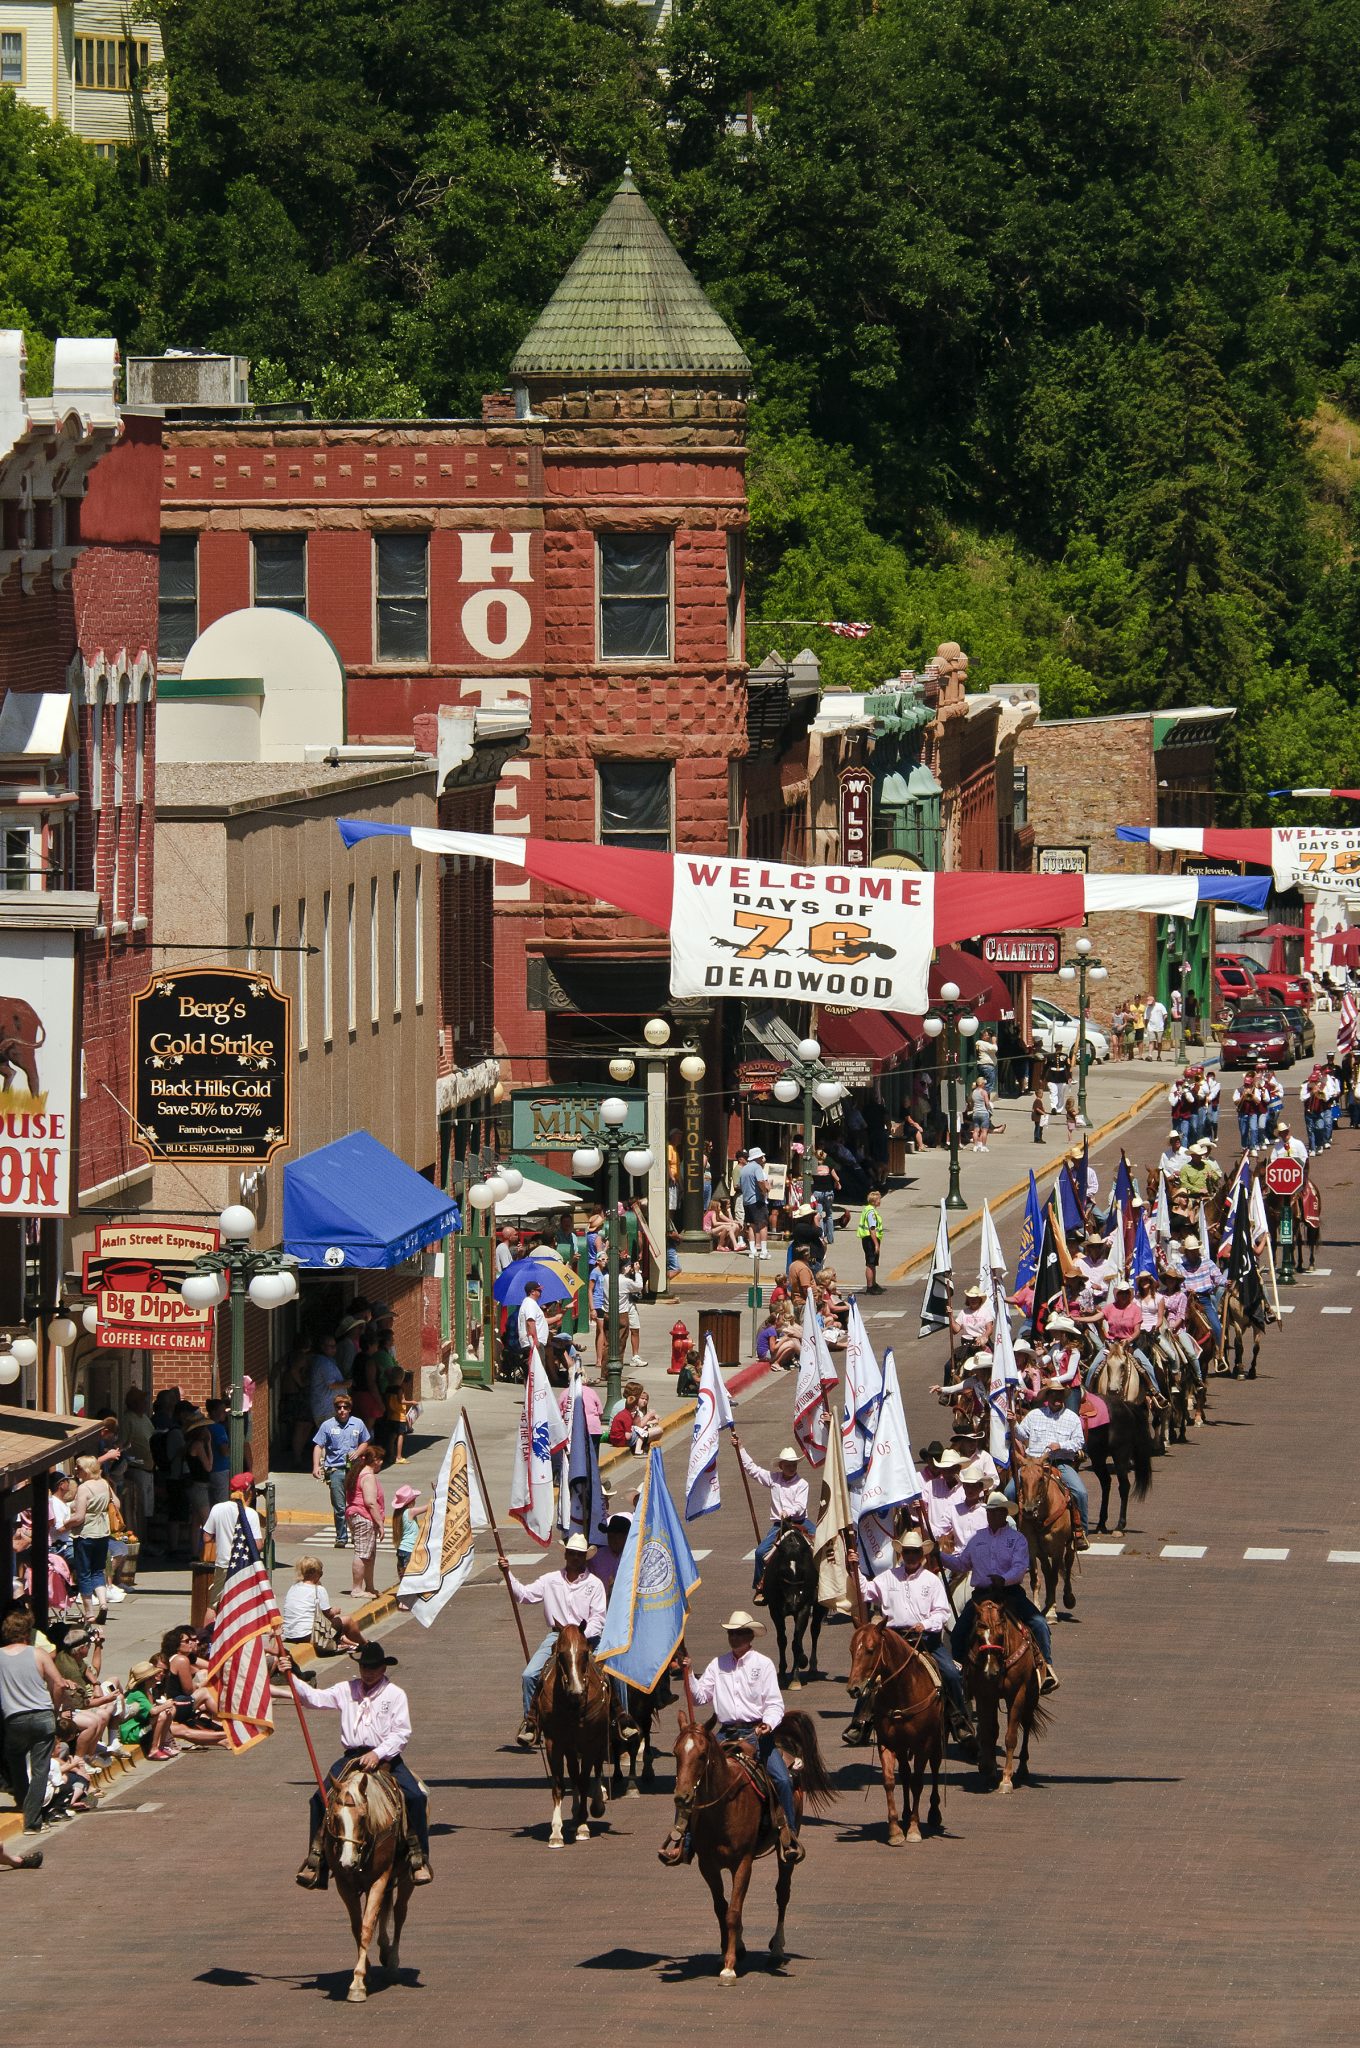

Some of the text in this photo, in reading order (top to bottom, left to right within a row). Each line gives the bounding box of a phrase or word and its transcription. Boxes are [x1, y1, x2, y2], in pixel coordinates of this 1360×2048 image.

[848, 781, 866, 840] WILD
[1278, 829, 1360, 843] WELCO
[1299, 840, 1339, 850] DAYS
[688, 863, 921, 906] WELCOME
[733, 893, 873, 917] DAYS OF
[734, 910, 871, 965] 76
[704, 965, 893, 999] DEADWOOD
[178, 996, 246, 1025] Berg's
[150, 1033, 274, 1056] Gold Strike
[150, 1080, 272, 1097] Black Hills Gold
[158, 1102, 262, 1118] Save 50% to 75%
[559, 1098, 597, 1110] THE
[0, 1113, 66, 1139] USE
[178, 1125, 242, 1136] Family Owned
[533, 1111, 600, 1134] MIN
[190, 1144, 240, 1153] ESTABLISHED
[687, 1117, 700, 1193] HOTEL
[1268, 1168, 1300, 1182] STOP
[102, 1233, 213, 1252] Main Street Espresso
[106, 1293, 201, 1322] Big Dippe
[102, 1332, 206, 1348] COFFEE ICE CREAM
[876, 1440, 891, 1456] 05
